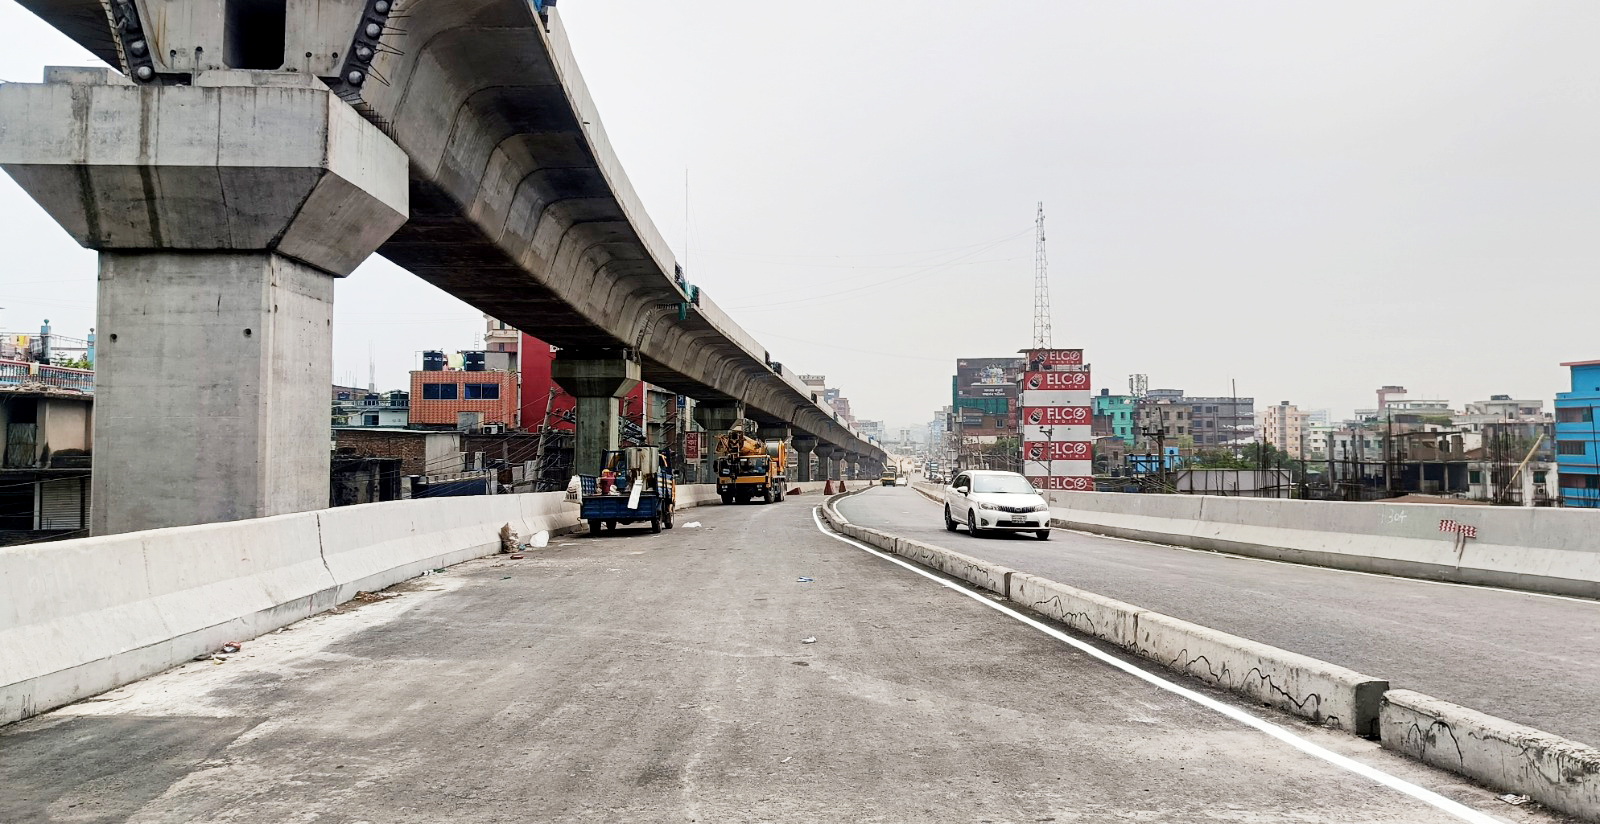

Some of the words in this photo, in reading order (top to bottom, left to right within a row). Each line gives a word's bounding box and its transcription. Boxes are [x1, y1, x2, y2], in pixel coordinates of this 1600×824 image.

[1049, 351, 1080, 360] ELCO
[1046, 373, 1086, 384] ELCO
[1047, 407, 1086, 420] ELCO
